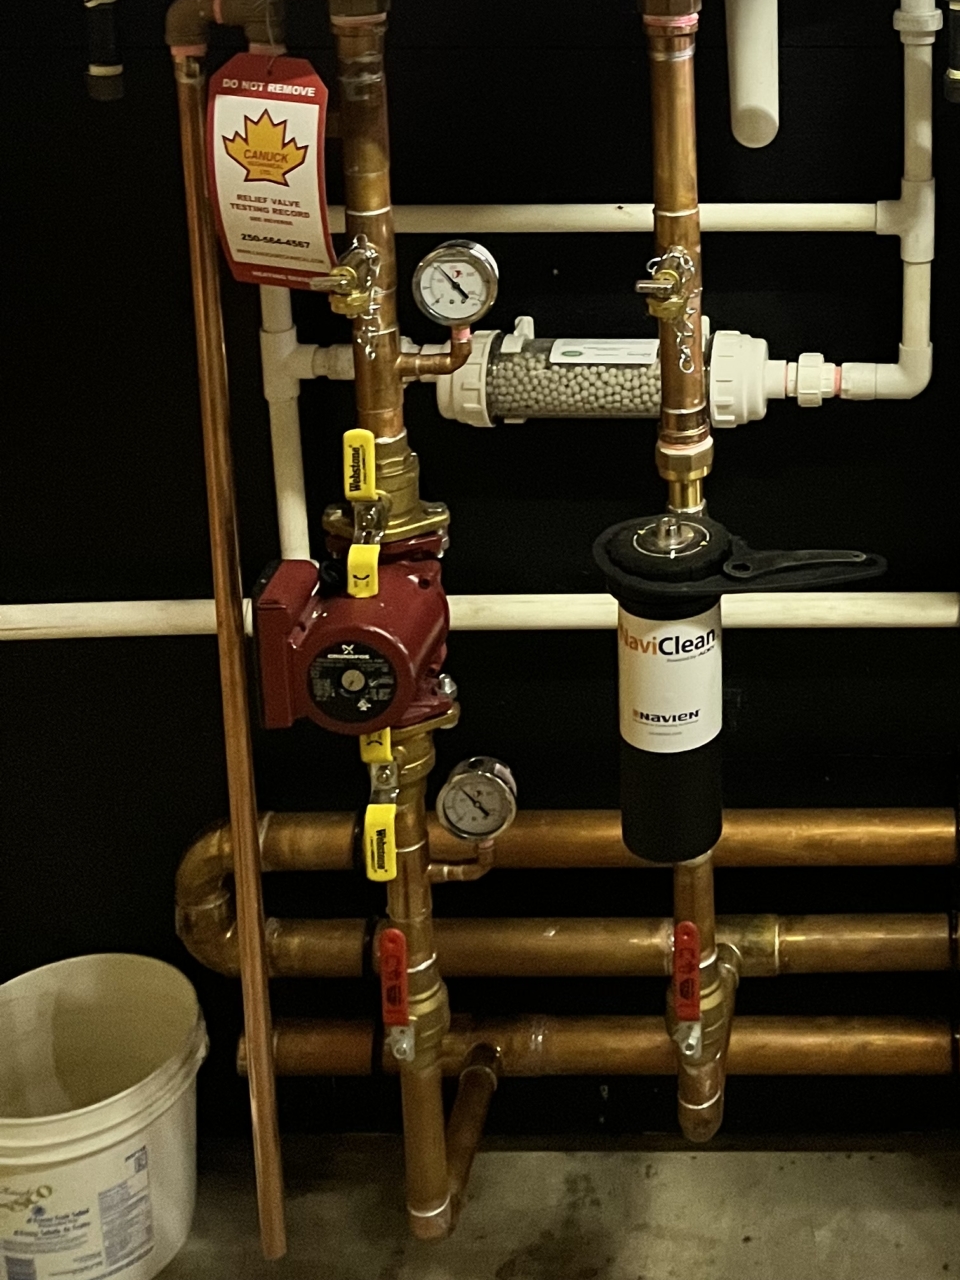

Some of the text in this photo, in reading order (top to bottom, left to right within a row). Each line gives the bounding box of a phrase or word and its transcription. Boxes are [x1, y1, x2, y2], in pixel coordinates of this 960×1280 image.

[222, 78, 316, 97] DO NOT REMOVE
[243, 149, 289, 164] CANUCK
[236, 193, 301, 209] RELIEF VALVE
[230, 202, 310, 219] TESTING RECORD
[348, 446, 362, 493] Webstone
[619, 624, 716, 656] NaviClean
